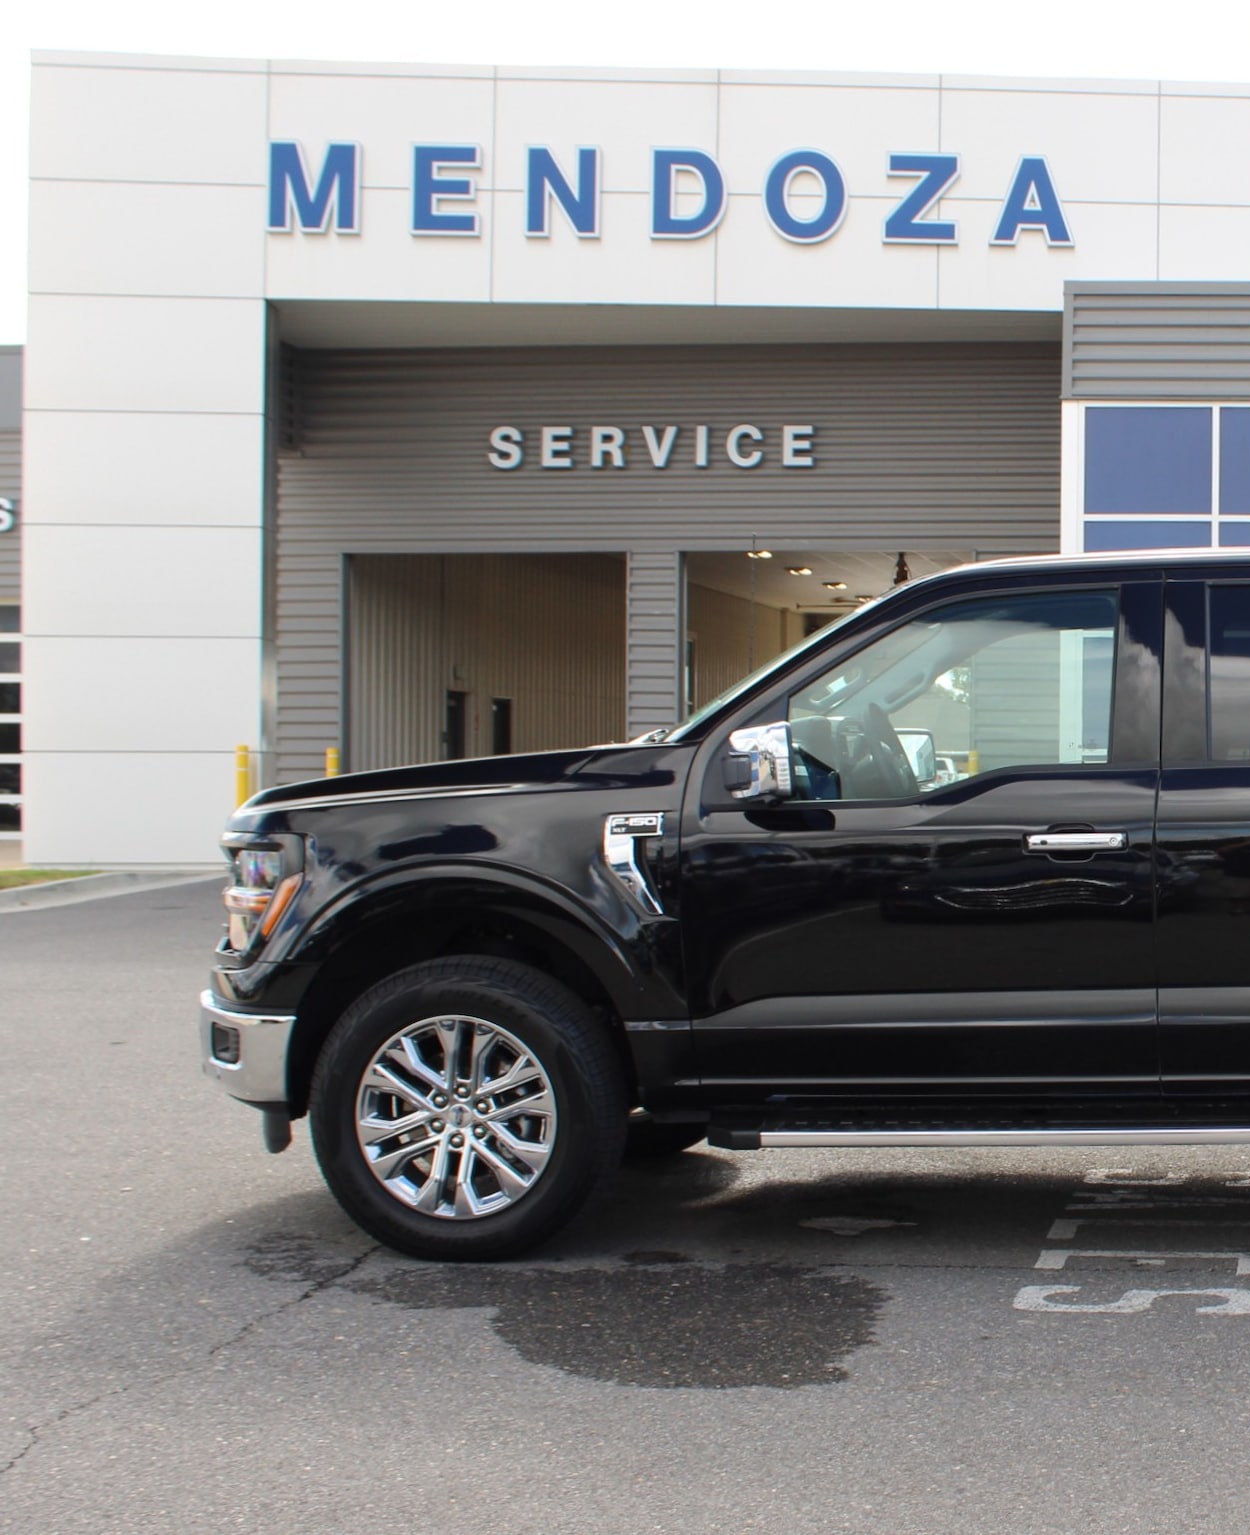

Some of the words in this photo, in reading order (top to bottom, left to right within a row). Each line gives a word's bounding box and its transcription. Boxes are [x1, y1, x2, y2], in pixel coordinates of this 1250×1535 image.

[267, 140, 1076, 248] MENDOZA
[488, 424, 817, 469] SERVICE
[613, 817, 657, 827] F-150
